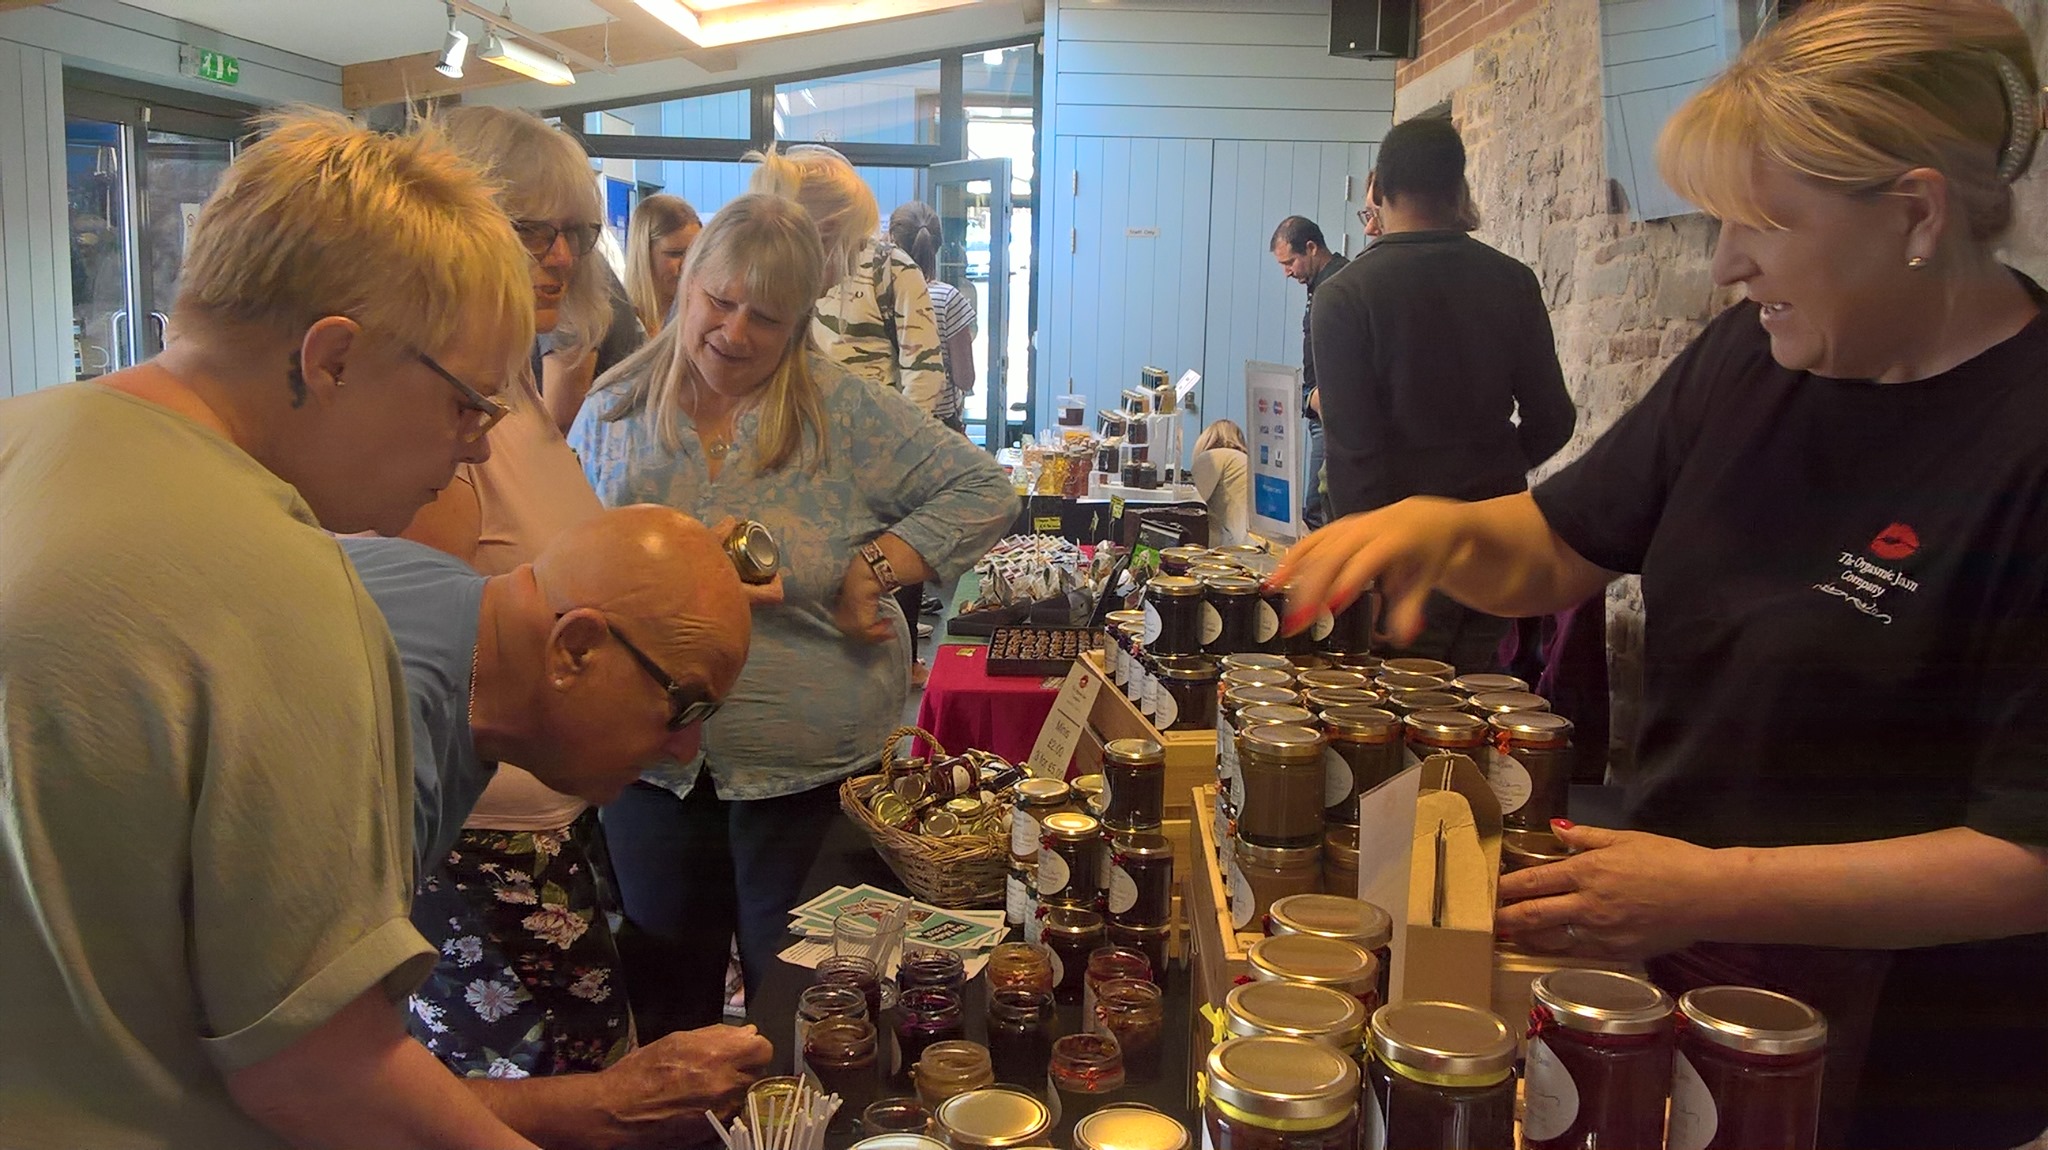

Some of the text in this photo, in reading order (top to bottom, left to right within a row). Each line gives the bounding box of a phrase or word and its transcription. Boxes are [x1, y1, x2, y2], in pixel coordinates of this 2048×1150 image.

[1838, 552, 1919, 592] The Orgasmic Jam
[1840, 570, 1886, 598] Company
